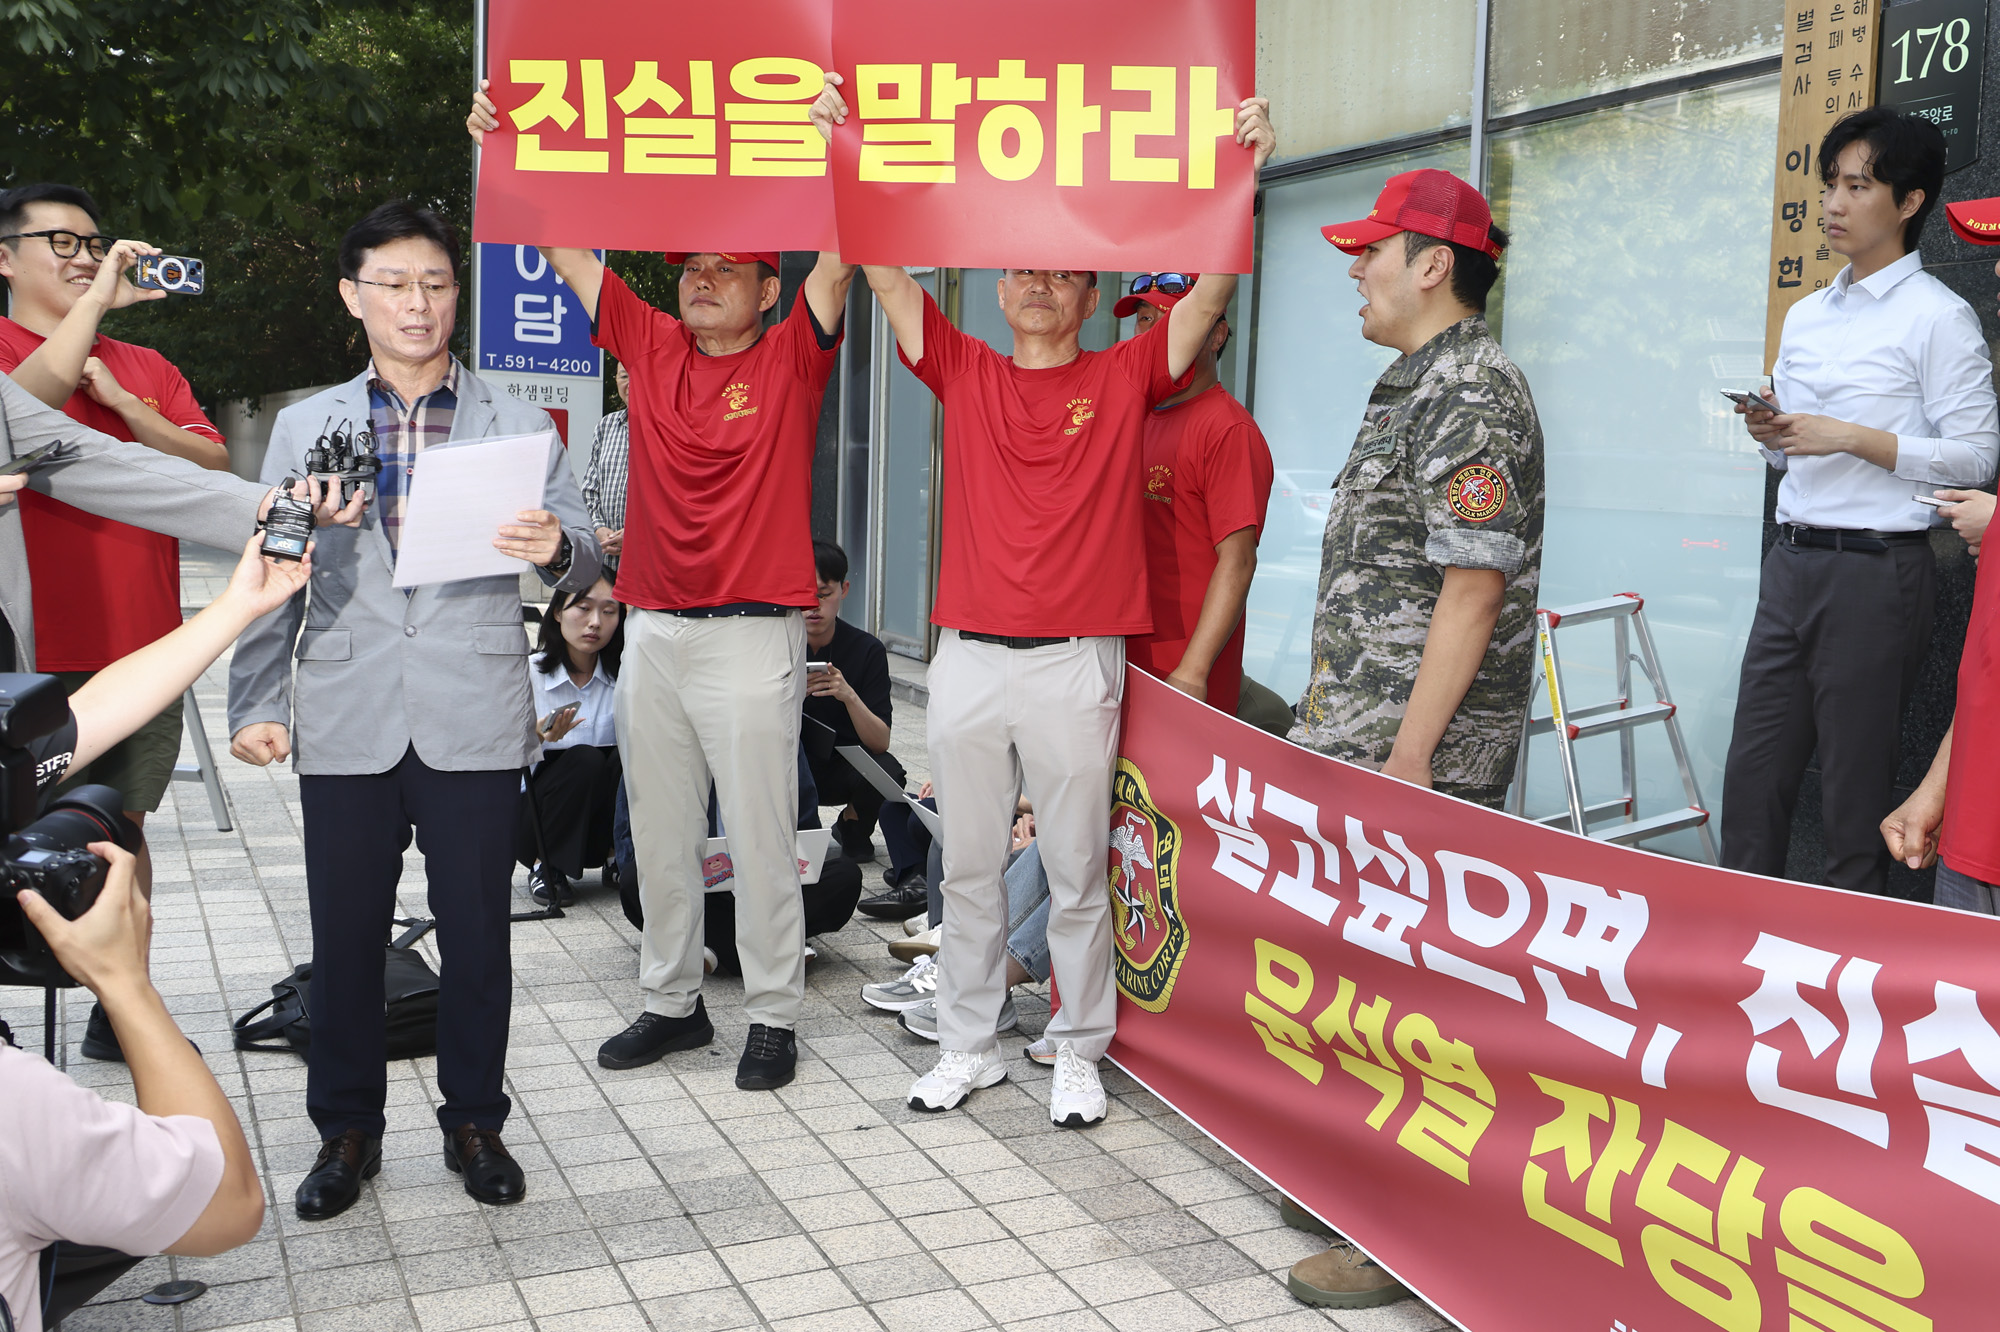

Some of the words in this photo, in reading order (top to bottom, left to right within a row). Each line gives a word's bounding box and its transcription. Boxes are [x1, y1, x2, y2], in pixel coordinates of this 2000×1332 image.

[1793, 9, 1814, 96] 별검사
[1828, 4, 1845, 49] 은폐
[1891, 17, 1971, 84] 178
[1825, 68, 1842, 114] 등의
[1848, 63, 1864, 109] 수사
[508, 57, 828, 177] 진실을
[856, 59, 1235, 190] 말하라
[1330, 234, 1358, 245] ROKMC
[1777, 143, 1811, 288] 이명현
[1966, 218, 2000, 231] ROKM
[486, 353, 591, 374] T.591-4200
[1197, 754, 1683, 1090] 살고싶으면,
[1151, 922, 1182, 991] CORPS
[1245, 938, 1496, 1186] 윤석열
[1522, 1073, 1934, 1332] 잔당을
